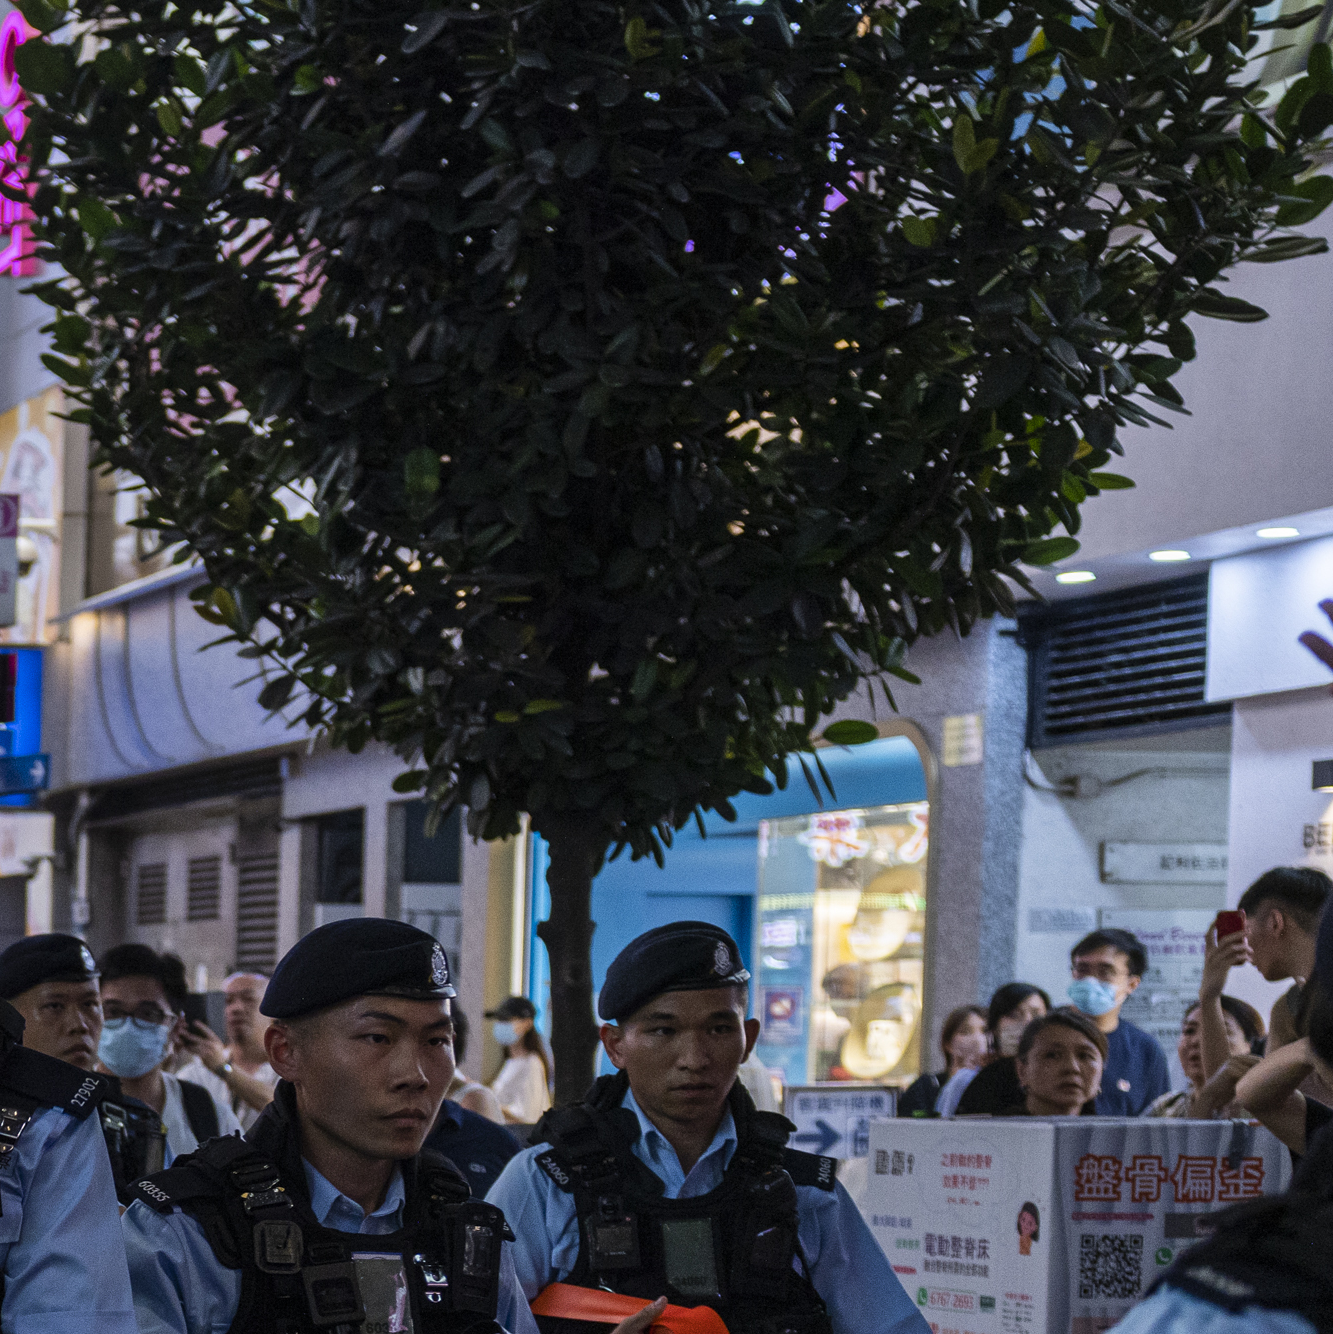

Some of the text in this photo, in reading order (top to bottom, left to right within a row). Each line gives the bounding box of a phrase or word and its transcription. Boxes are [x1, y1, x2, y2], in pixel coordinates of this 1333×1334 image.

[1303, 823, 1333, 848] BE
[70, 1077, 100, 1107] 27902
[542, 1157, 570, 1185] 24060
[818, 1157, 832, 1184] 24060
[138, 1181, 170, 1202] 60355
[366, 1321, 406, 1334] 603
